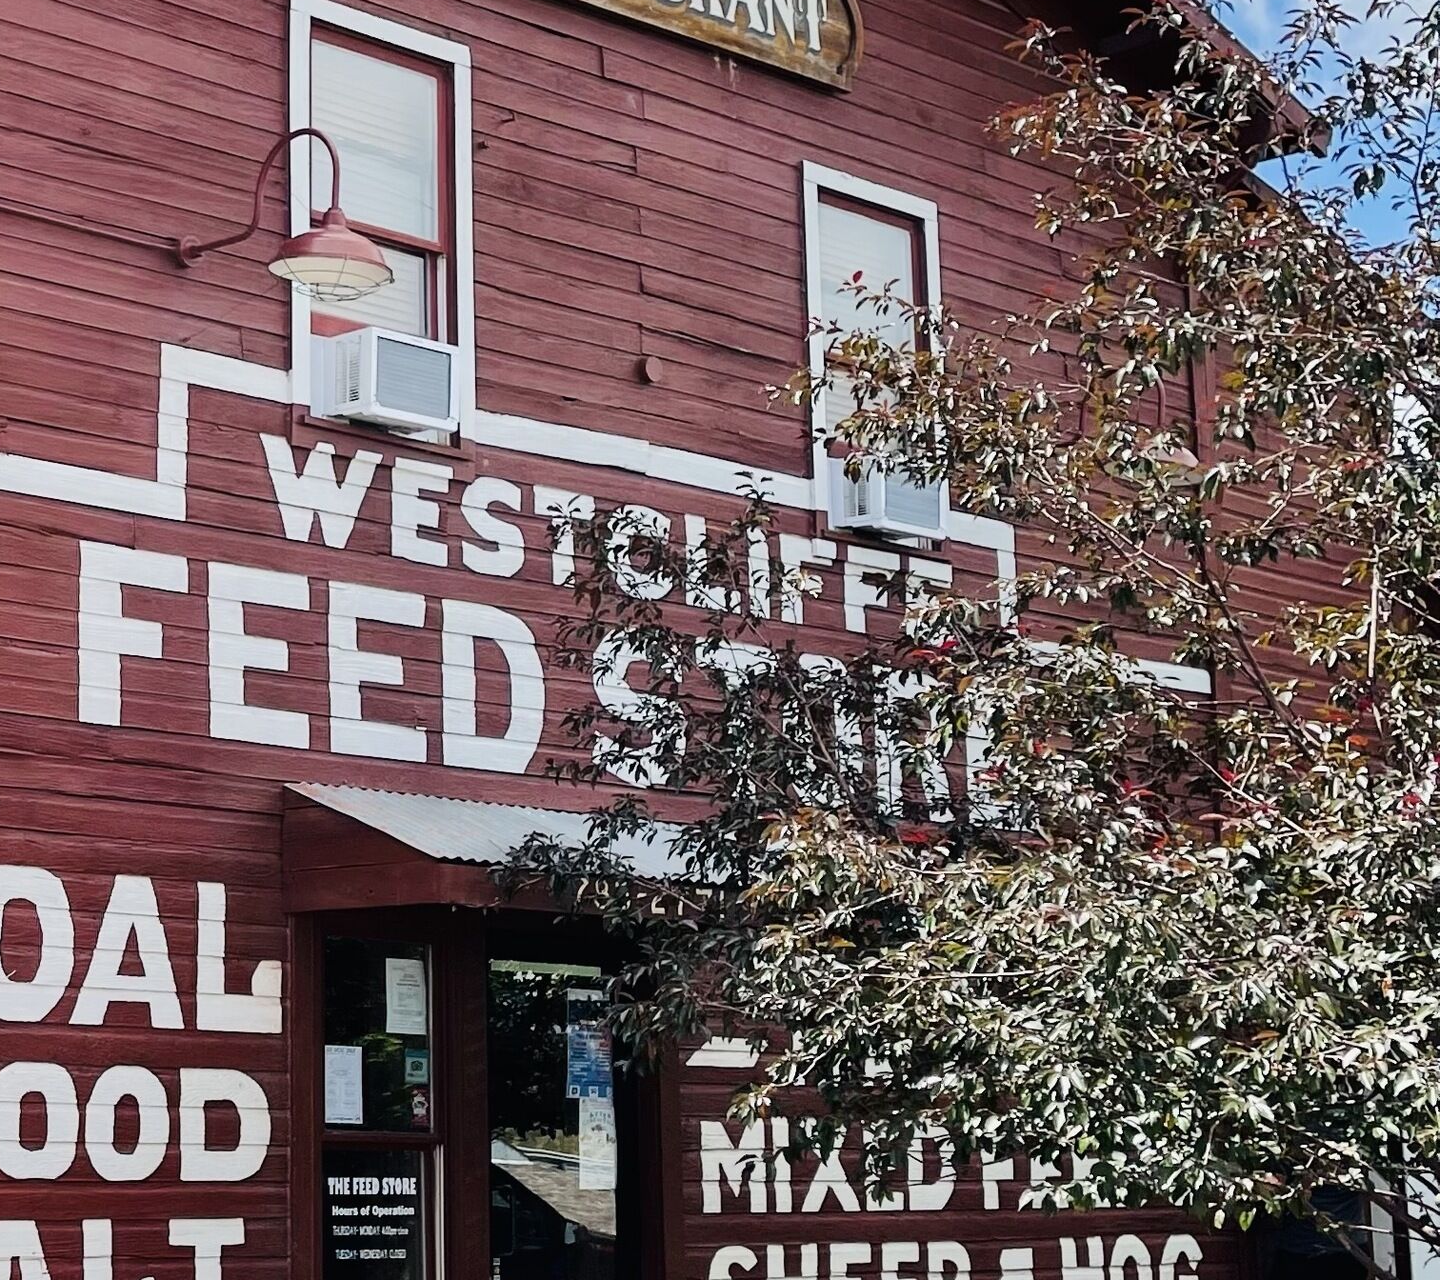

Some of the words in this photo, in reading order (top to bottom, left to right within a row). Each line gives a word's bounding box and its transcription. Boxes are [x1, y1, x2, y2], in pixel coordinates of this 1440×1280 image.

[77, 539, 546, 774] FEED
[327, 1177, 351, 1195] THE
[352, 1177, 380, 1195] FEED
[381, 1177, 417, 1195] STORE
[699, 1116, 957, 1213] MIXED
[331, 1205, 359, 1216] Hours
[360, 1205, 371, 1216] of
[372, 1205, 415, 1218] Operation
